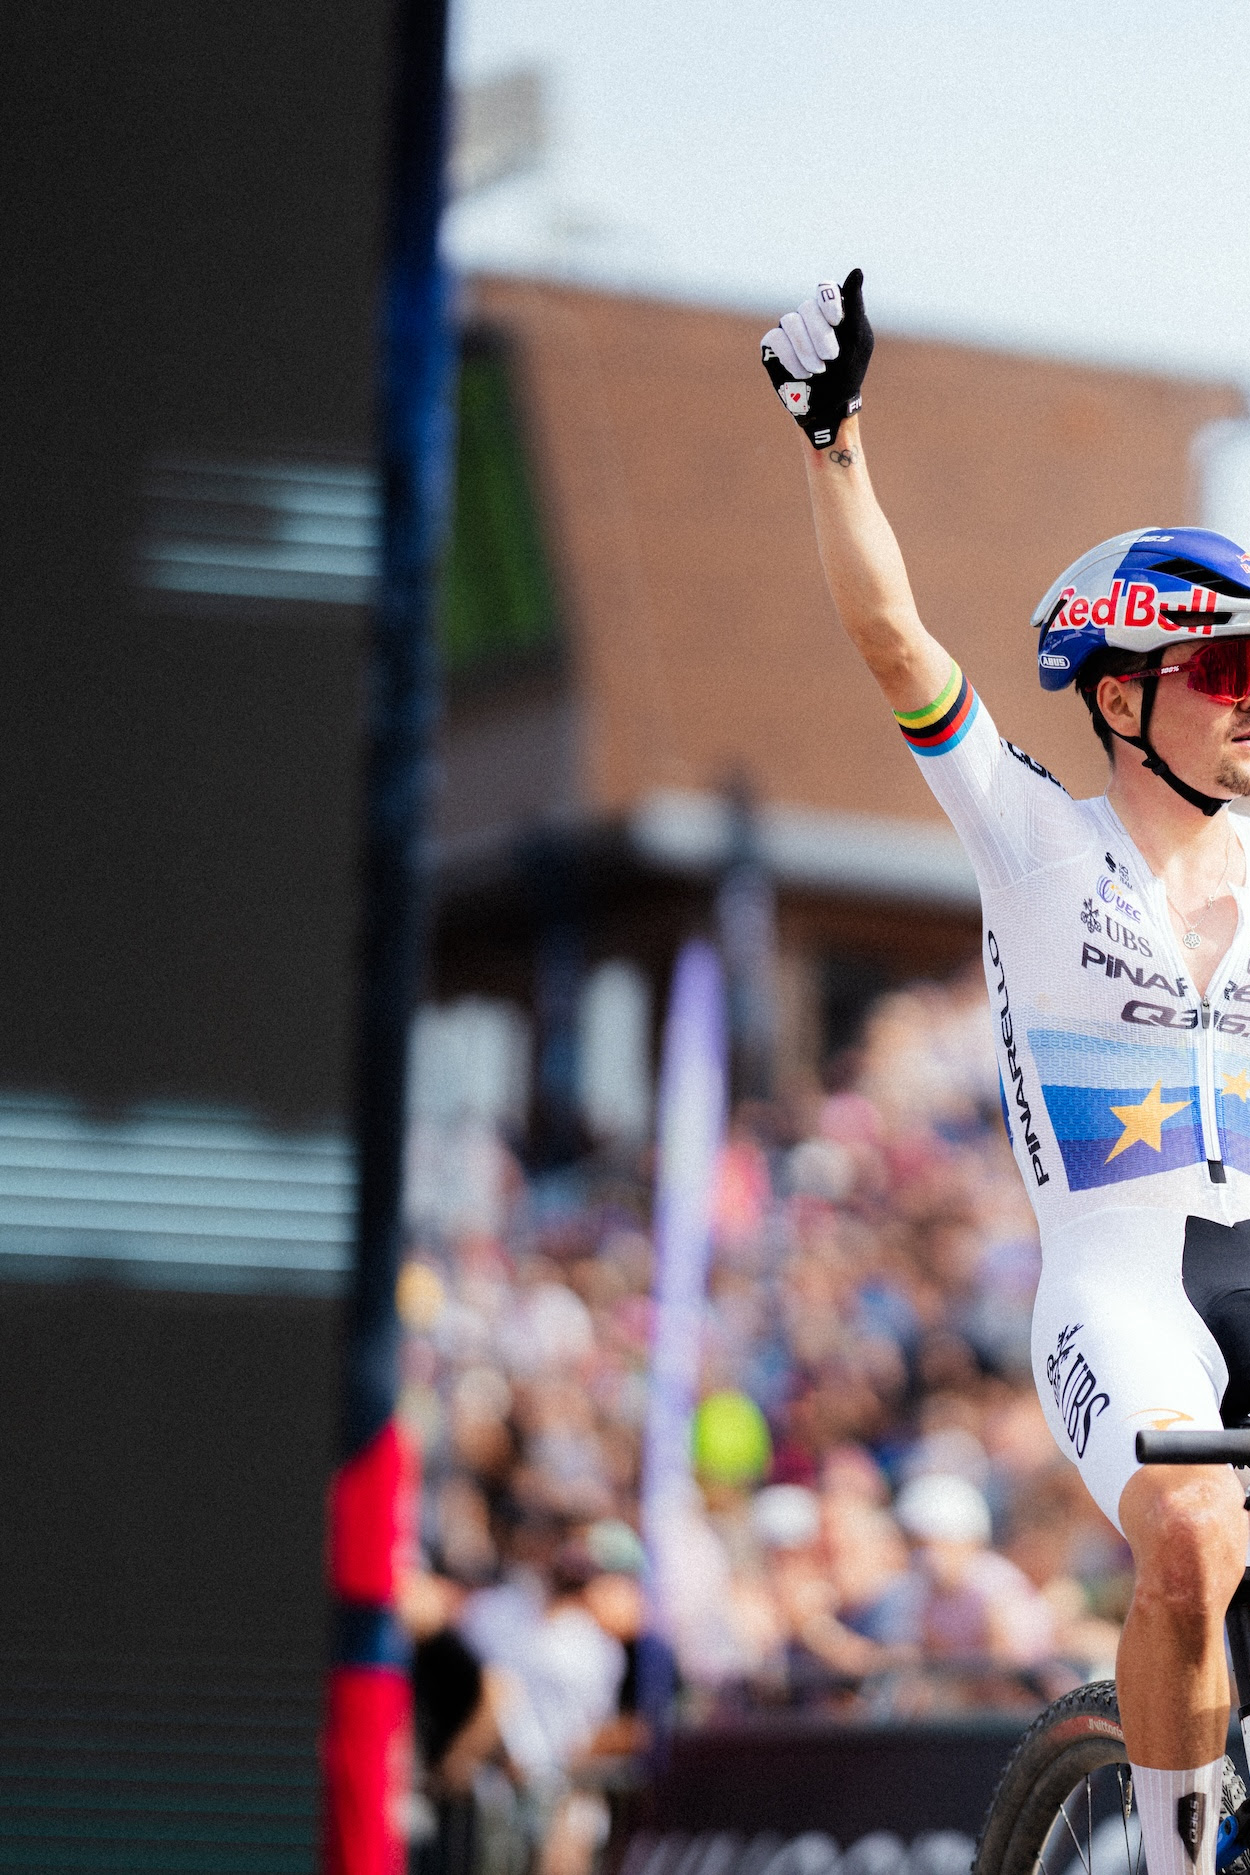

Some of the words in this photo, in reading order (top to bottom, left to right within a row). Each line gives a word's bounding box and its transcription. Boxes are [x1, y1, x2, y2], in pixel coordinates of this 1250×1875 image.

[1051, 581, 1122, 628] Red
[1124, 584, 1218, 636] Bull
[1042, 657, 1066, 667] ABUS
[1160, 665, 1180, 675] 100%
[1116, 896, 1142, 921] UEC
[1105, 914, 1153, 958] UBS
[1061, 1352, 1110, 1460] UBS
[1190, 1800, 1200, 1844] Q36.5
